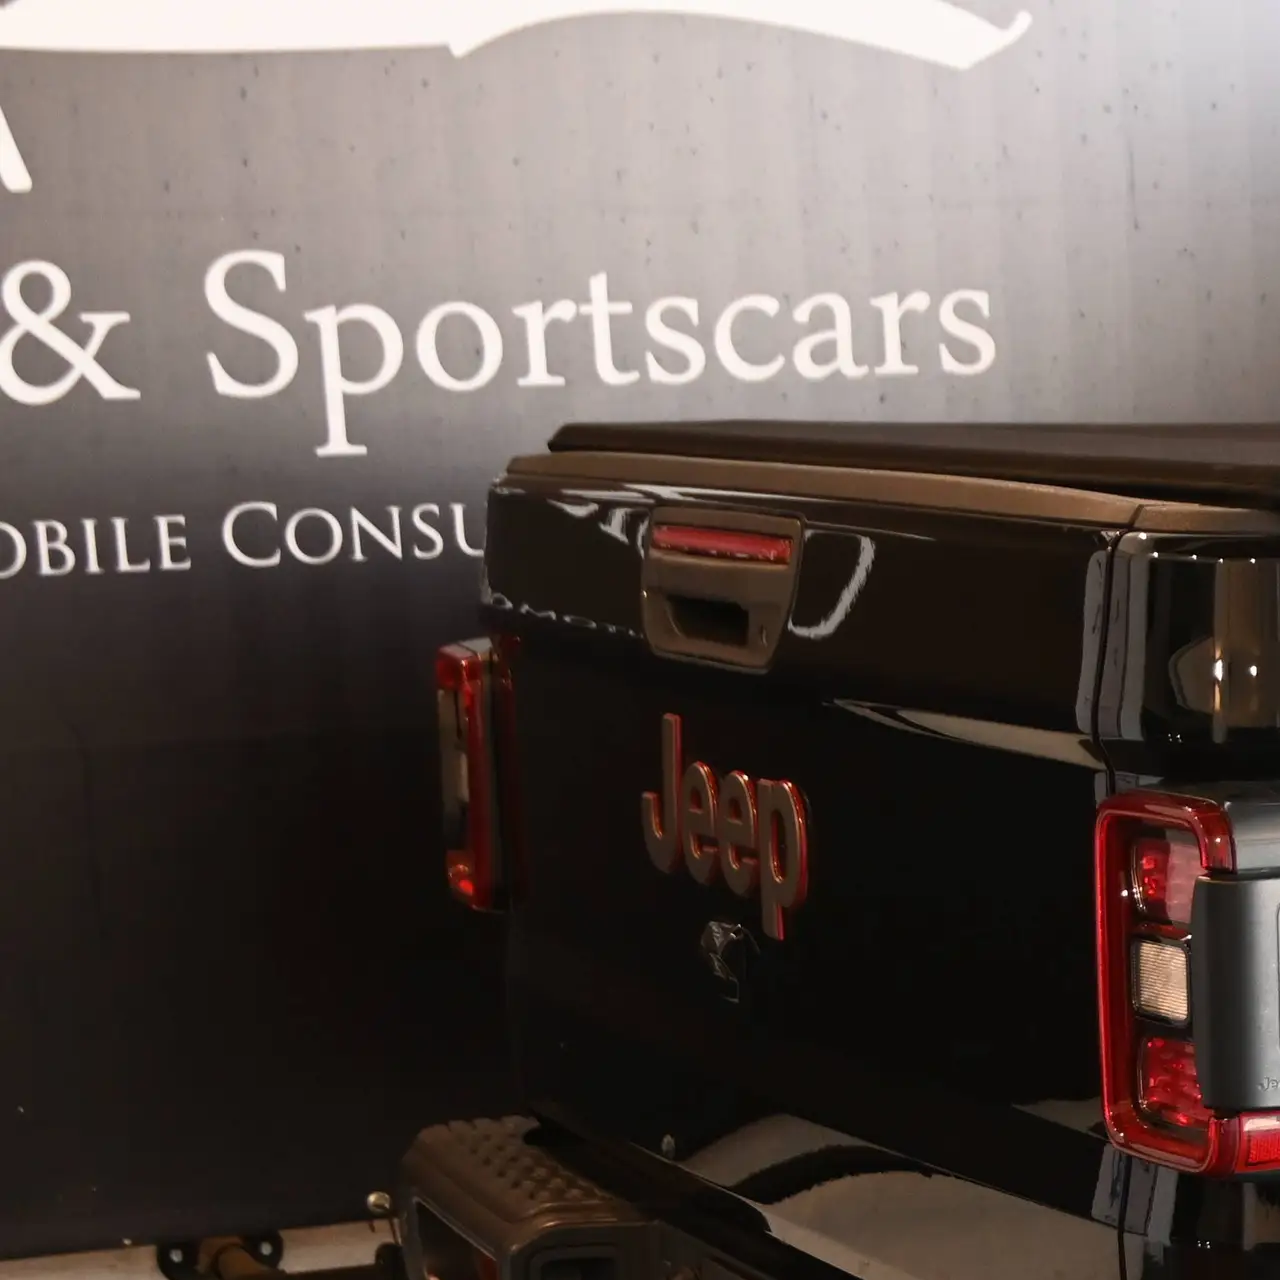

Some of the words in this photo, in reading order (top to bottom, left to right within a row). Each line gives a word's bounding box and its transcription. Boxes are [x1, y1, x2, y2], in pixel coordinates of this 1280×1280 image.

[0, 259, 141, 405] &
[203, 249, 997, 457] Sportscars
[641, 712, 808, 941] Jeep
